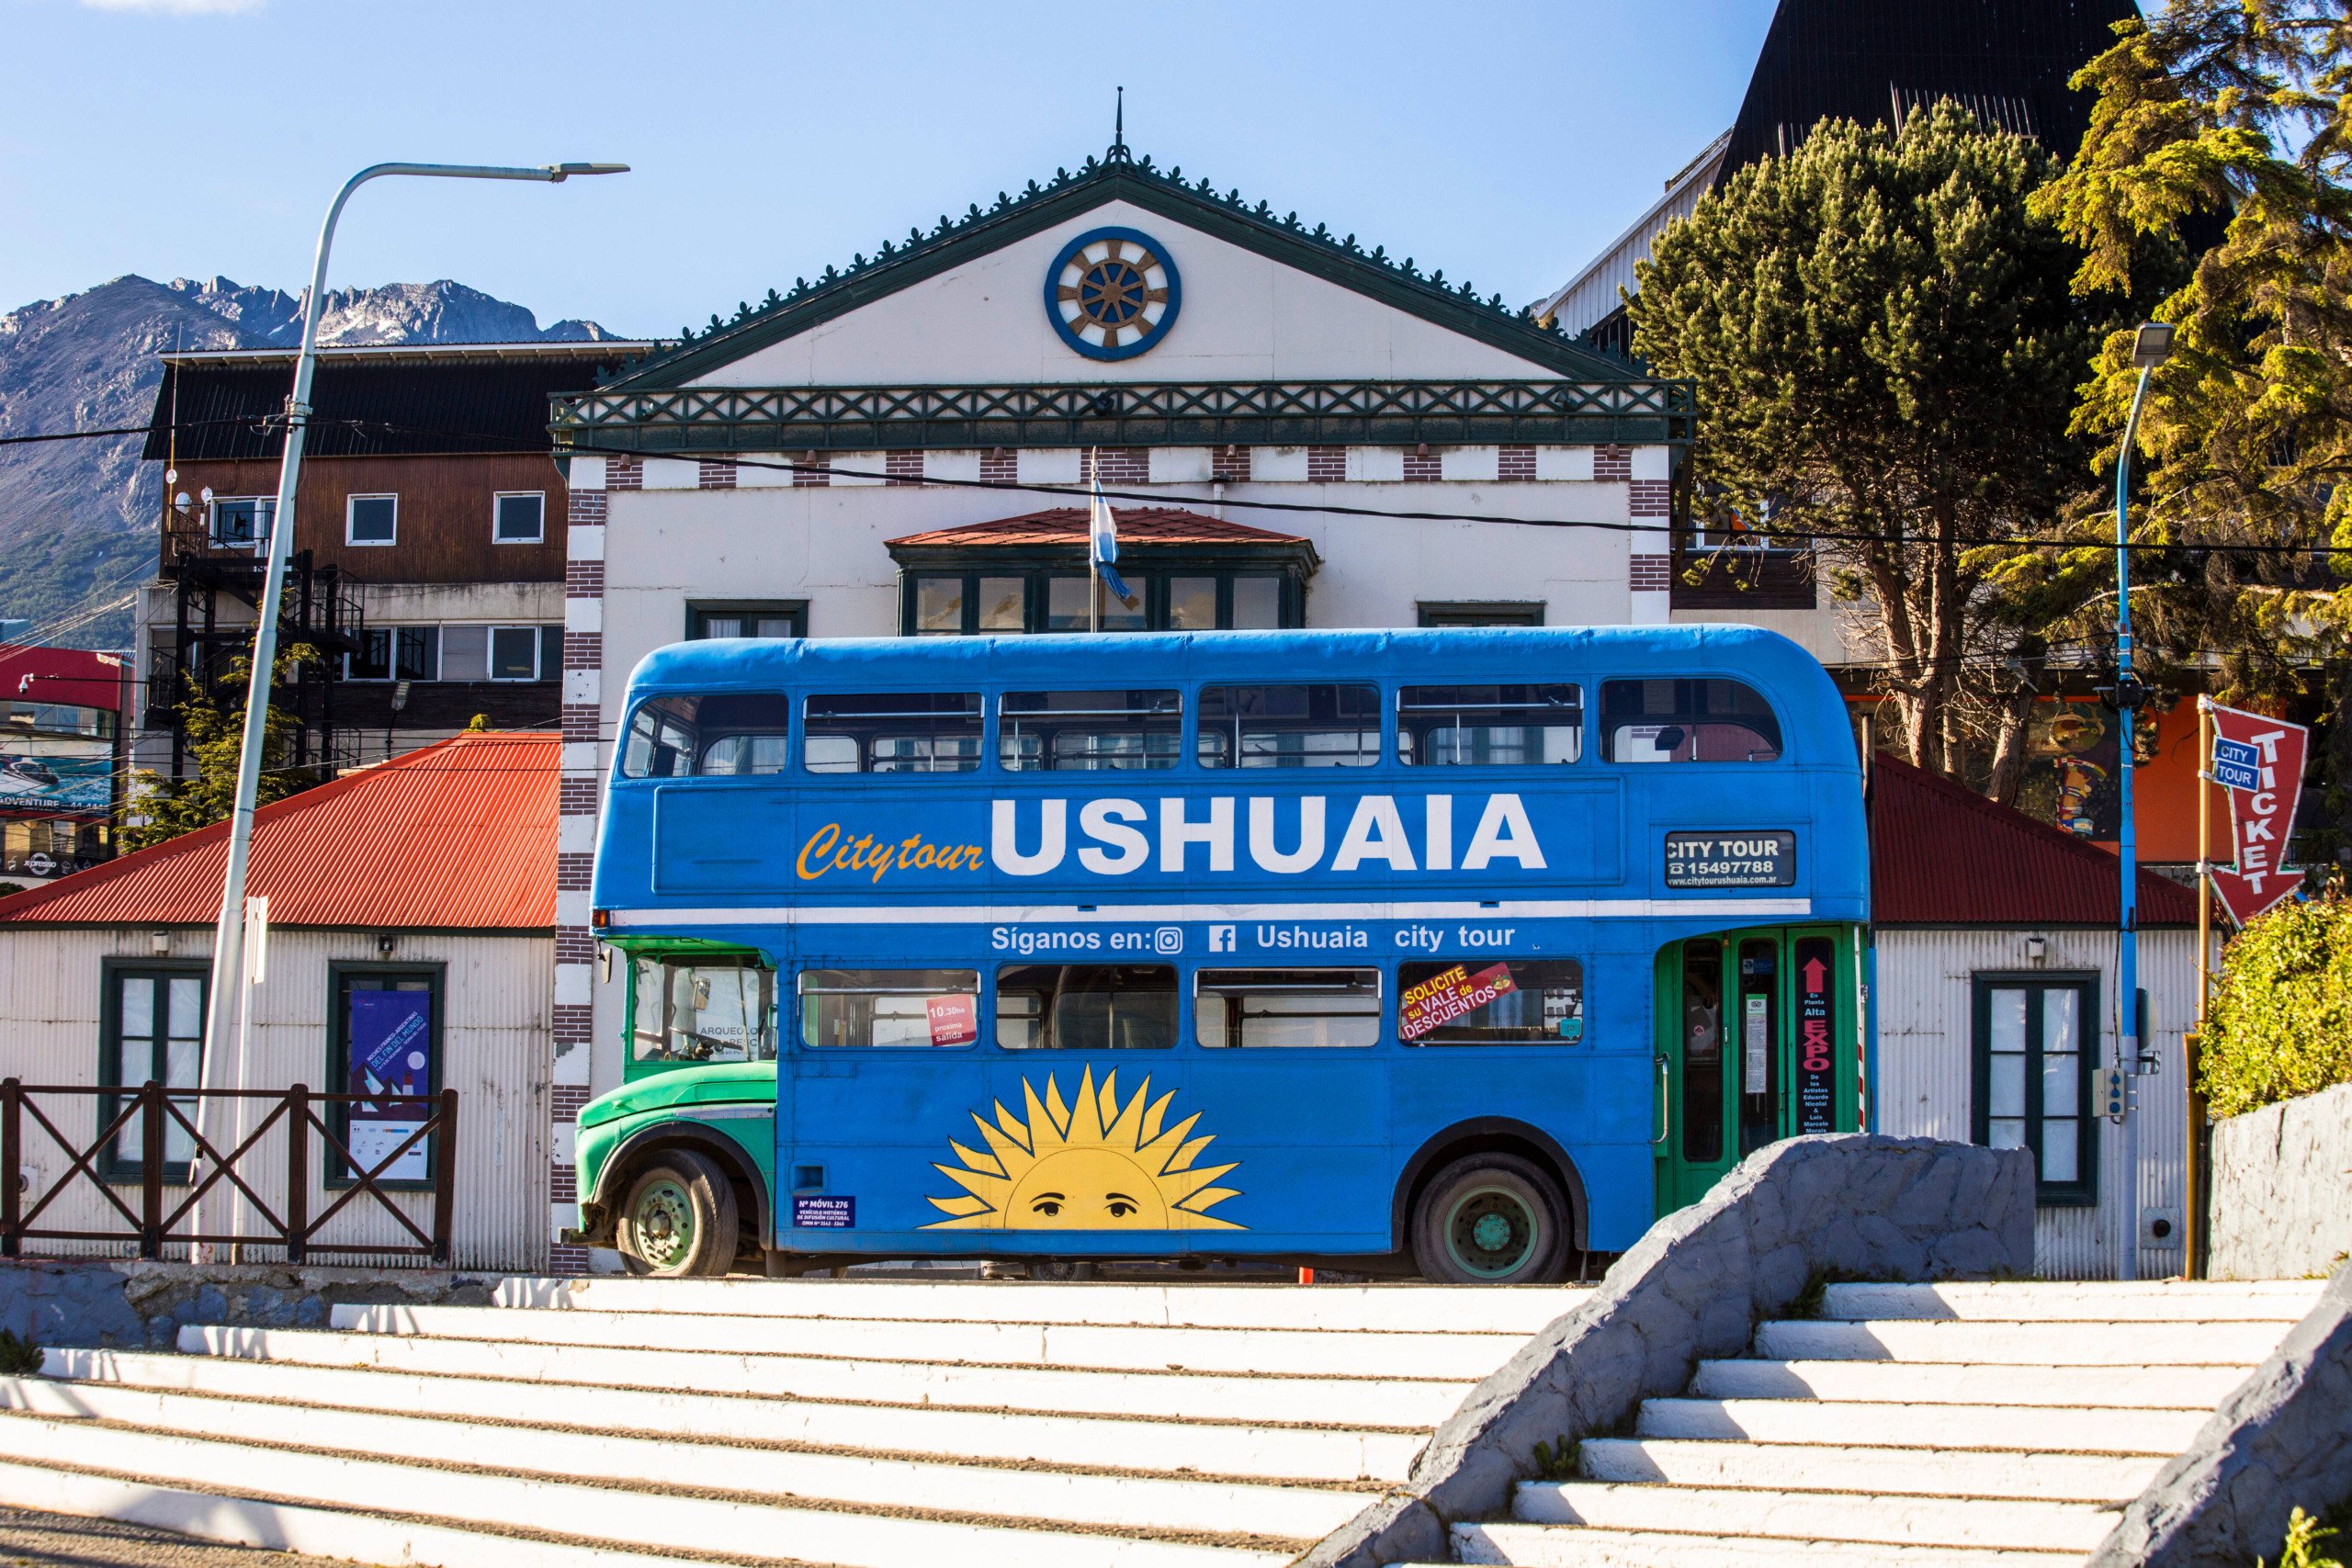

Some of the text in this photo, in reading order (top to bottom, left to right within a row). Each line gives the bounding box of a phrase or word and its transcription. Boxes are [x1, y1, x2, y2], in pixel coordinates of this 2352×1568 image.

[2221, 745, 2248, 762] CITY
[2219, 765, 2251, 784] TOUR
[2243, 730, 2286, 895] TICKET
[991, 794, 1547, 875] USHUAIA
[1667, 840, 1779, 859] CITY TOUR
[1688, 861, 1773, 874] 15497788
[991, 927, 1150, 955] Síganos en:
[1257, 925, 1368, 949] Ushuaia
[1395, 924, 1444, 953] city
[1458, 925, 1515, 947] tour
[1404, 966, 1467, 1005] SOLICITE
[1404, 985, 1497, 1039] DESCUENTOS
[1408, 984, 1473, 1020] su VALE de
[1804, 1008, 1826, 1016] Alta
[370, 1056, 384, 1067] DEL
[382, 1045, 393, 1057] FIN
[391, 1036, 404, 1048] DEL
[401, 1015, 424, 1037] MUNDO
[934, 1022, 963, 1032] proxima
[935, 1032, 963, 1042] salida
[1803, 1020, 1830, 1071] EXPO
[809, 1198, 834, 1209] MÓVIL
[835, 1201, 849, 1209] 276
